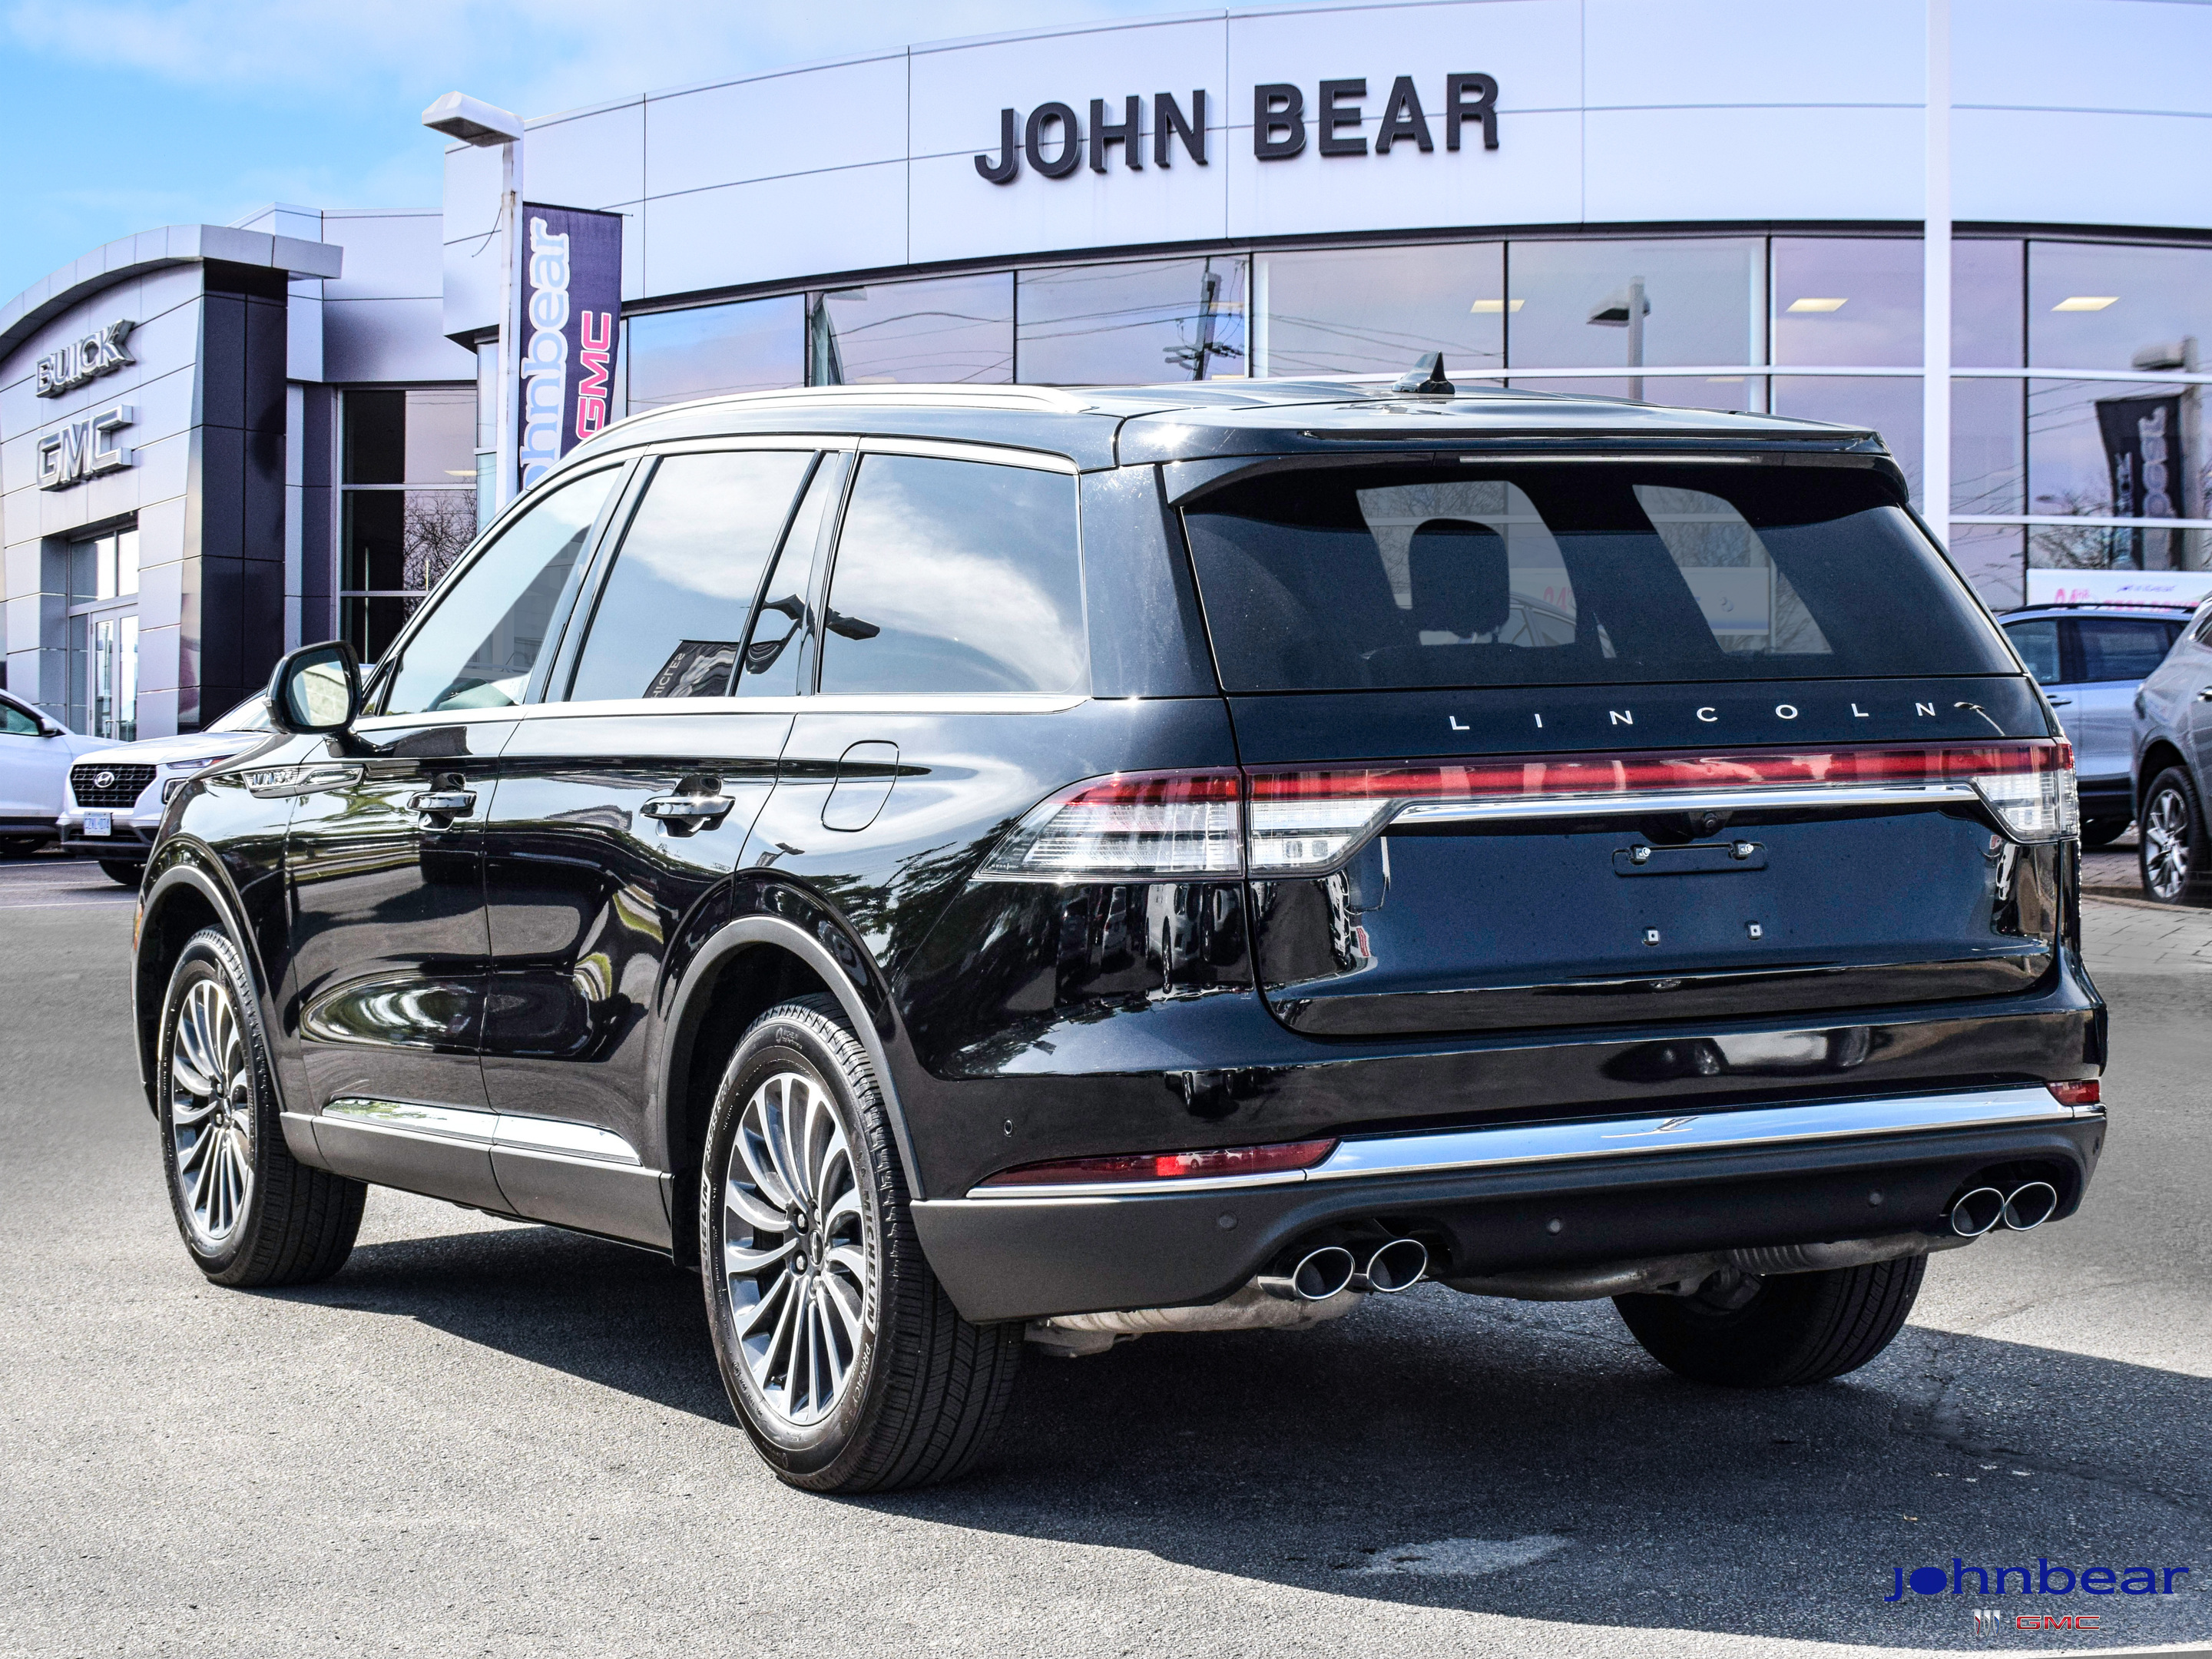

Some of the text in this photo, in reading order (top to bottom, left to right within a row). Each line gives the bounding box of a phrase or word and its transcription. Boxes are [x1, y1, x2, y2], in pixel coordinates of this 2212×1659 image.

[974, 72, 1500, 184] JOHN BEAR
[36, 319, 135, 398] BUICK
[575, 310, 611, 440] GMC
[37, 404, 133, 492] GMC
[1449, 702, 1937, 731] LINCOLN
[863, 1190, 877, 1326] MICHELIN
[852, 1342, 871, 1408] PRIMACY
